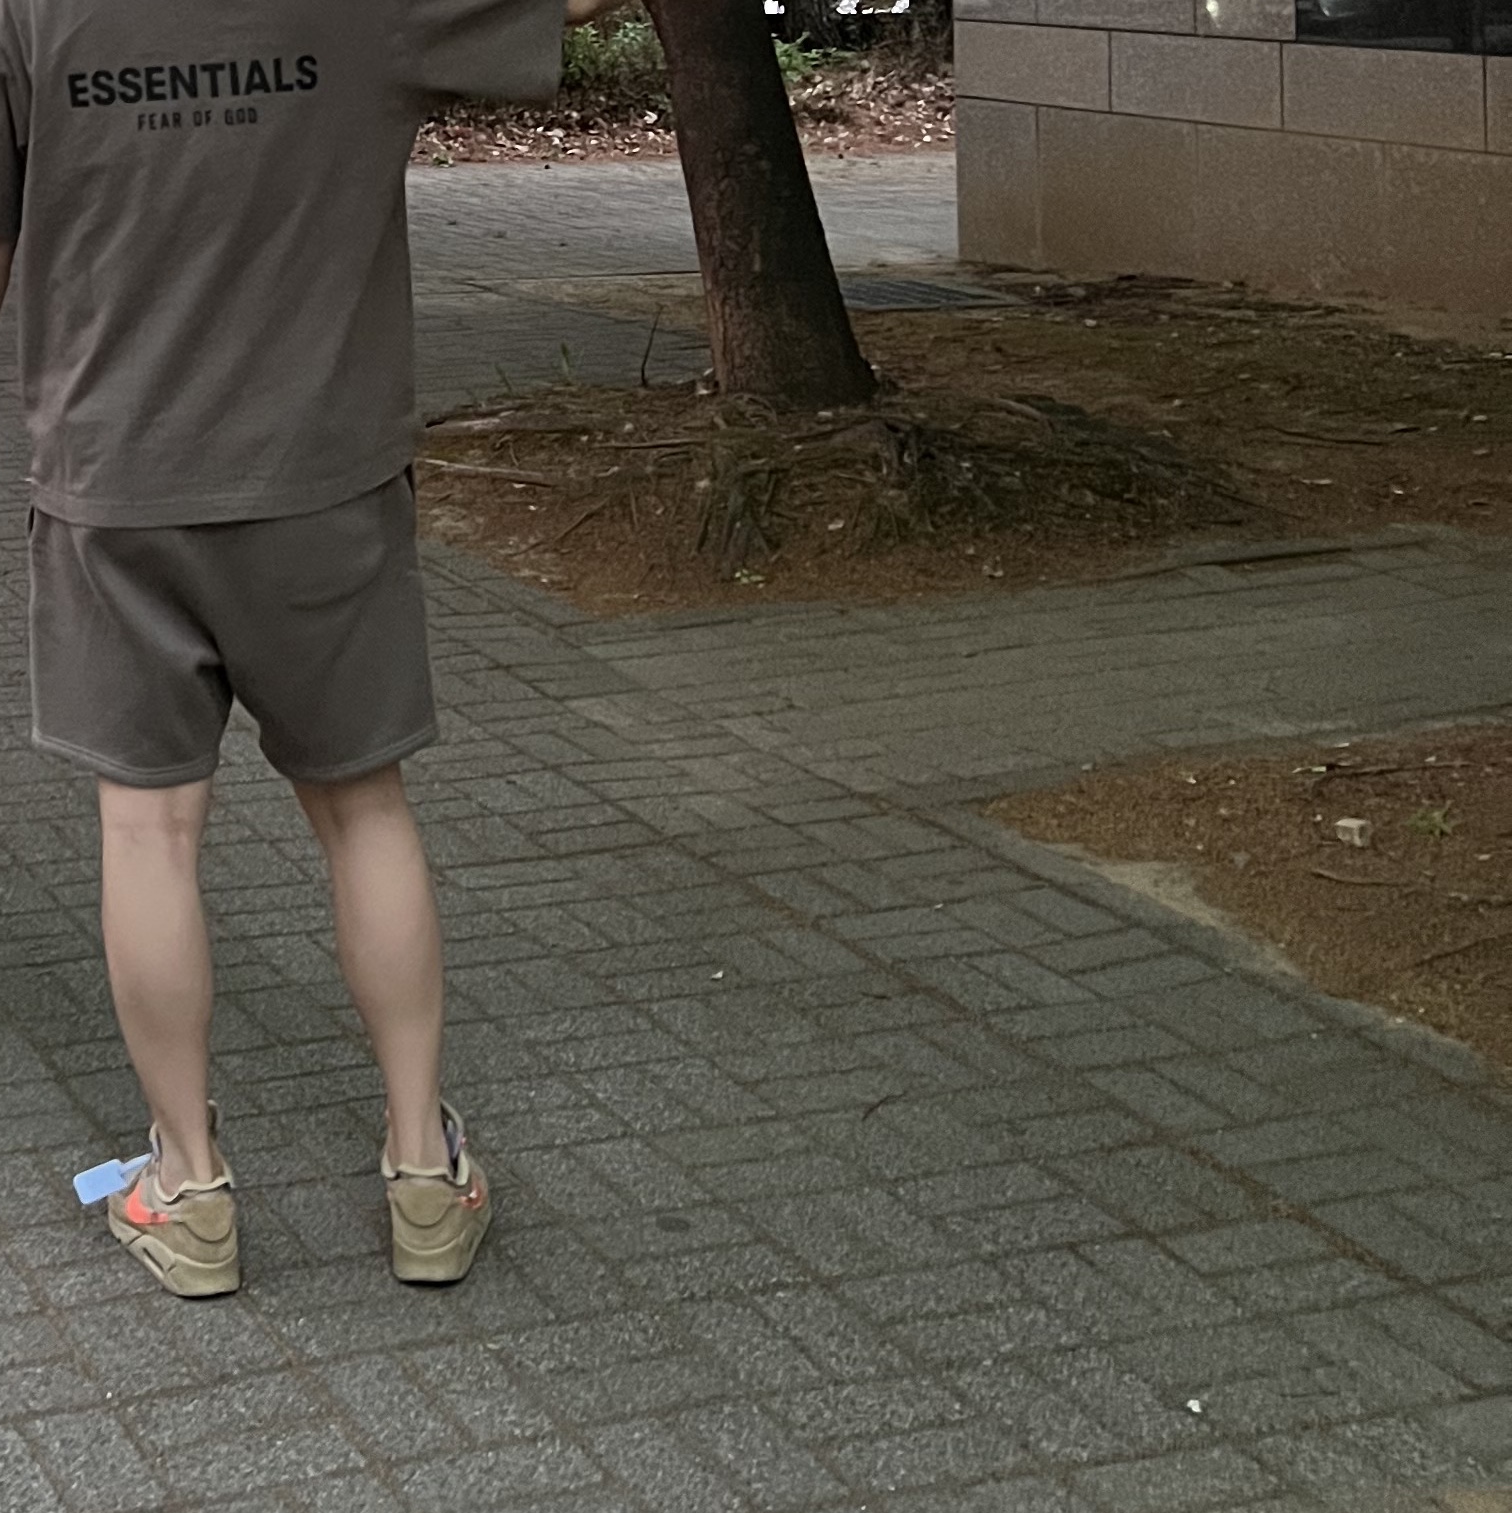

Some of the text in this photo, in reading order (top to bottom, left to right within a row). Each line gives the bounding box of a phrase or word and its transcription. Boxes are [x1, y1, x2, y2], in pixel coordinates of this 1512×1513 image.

[67, 54, 318, 108] ESSENTIALS
[137, 107, 258, 131] FEAR OF GOD
